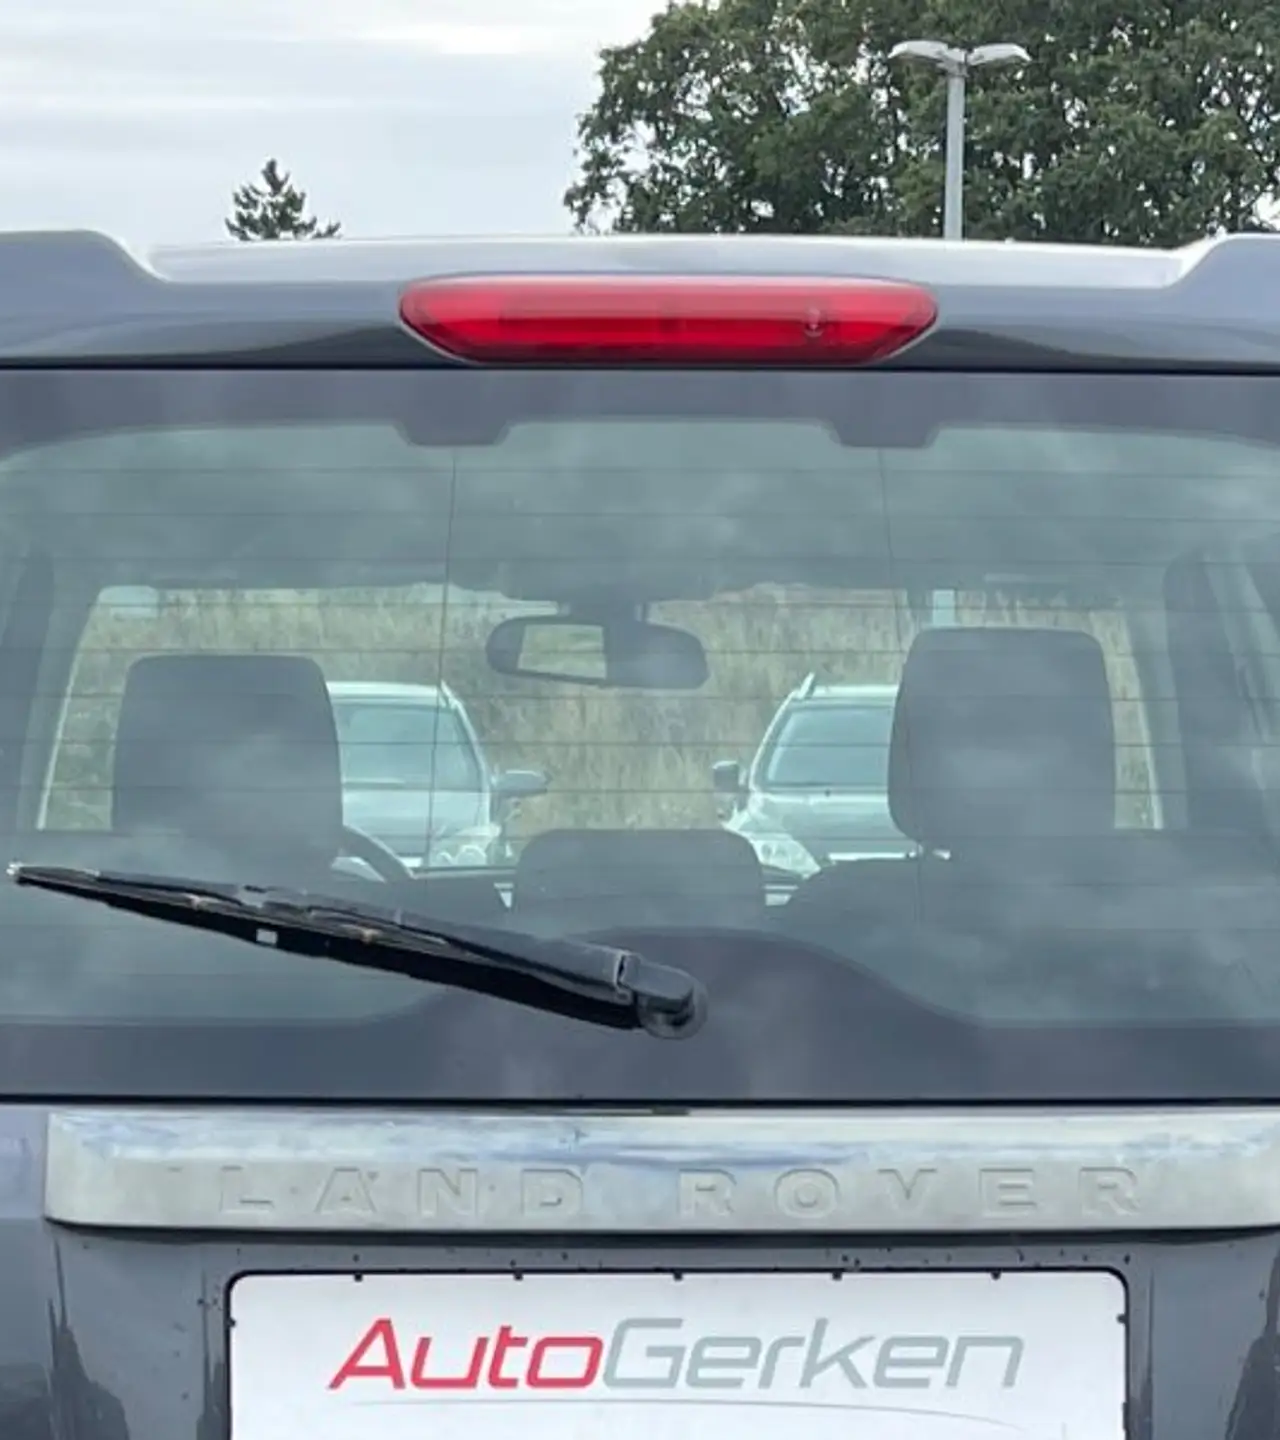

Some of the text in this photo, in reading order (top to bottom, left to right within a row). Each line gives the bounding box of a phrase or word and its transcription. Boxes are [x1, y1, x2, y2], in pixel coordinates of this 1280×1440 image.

[218, 1166, 1144, 1218] LAND ROVER
[328, 1316, 1025, 1390] AutoGerken
